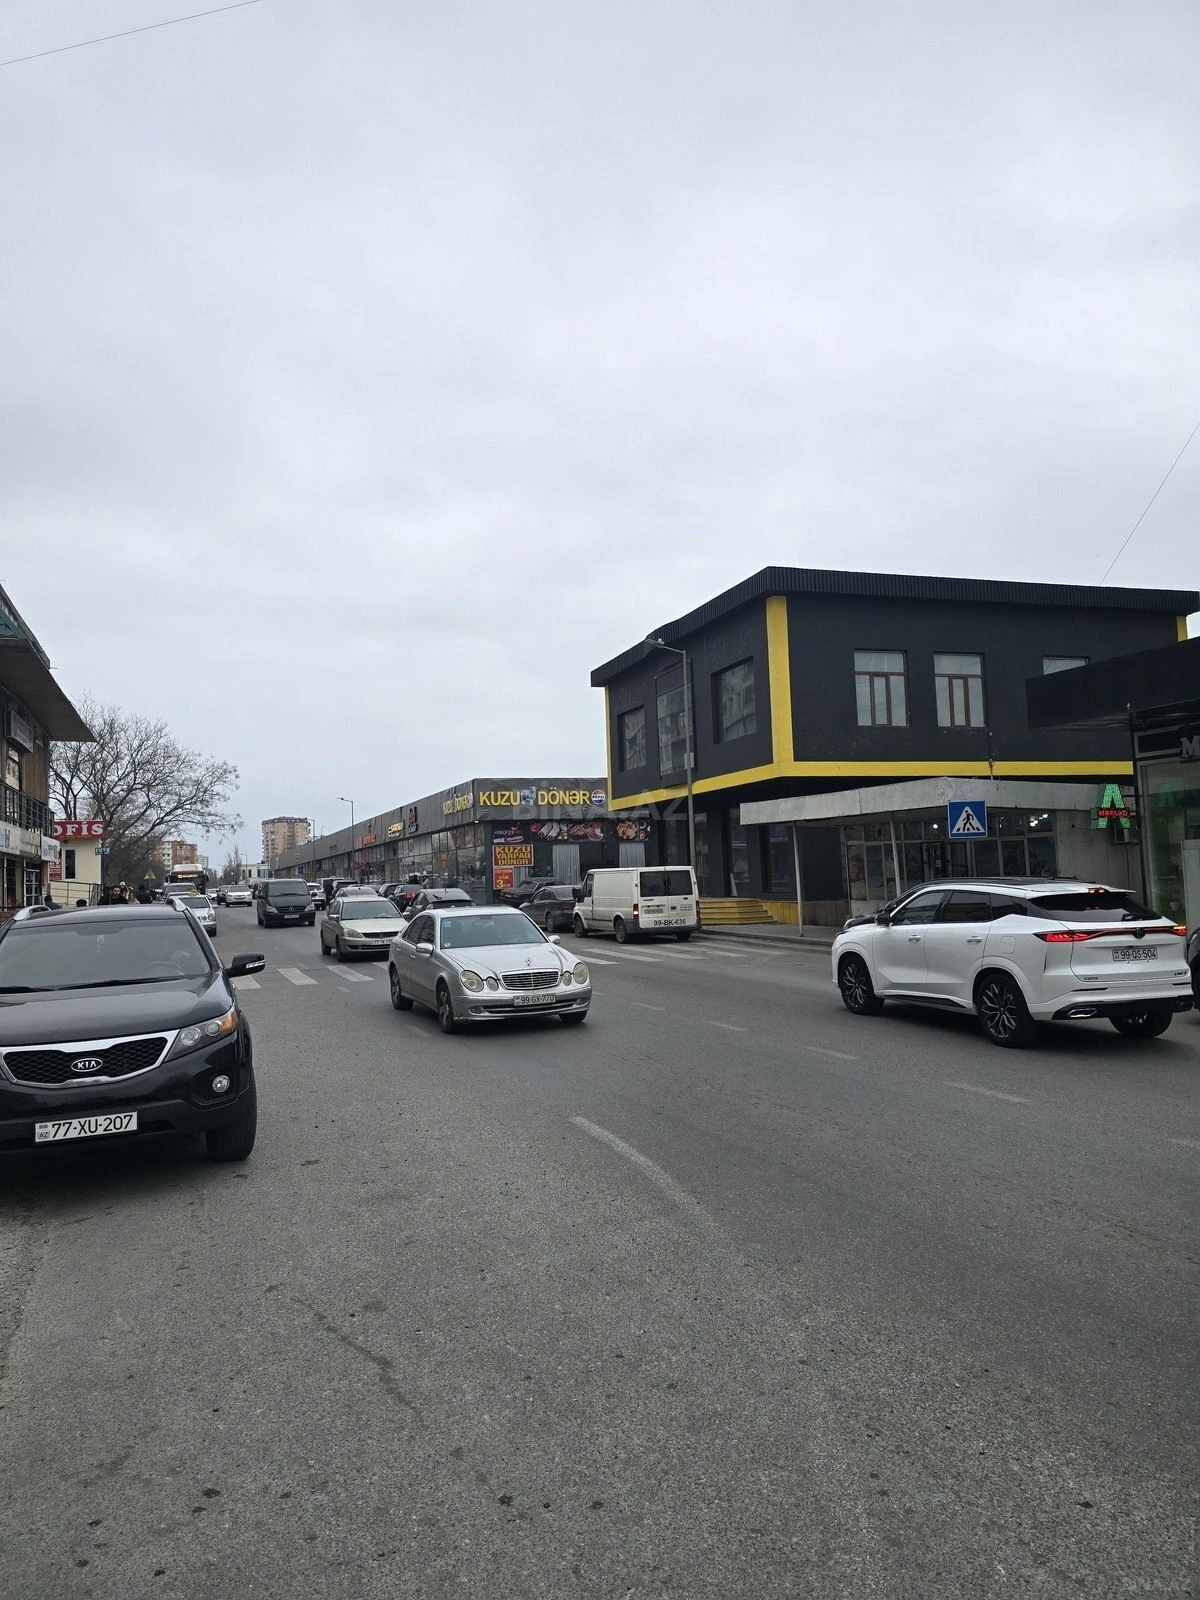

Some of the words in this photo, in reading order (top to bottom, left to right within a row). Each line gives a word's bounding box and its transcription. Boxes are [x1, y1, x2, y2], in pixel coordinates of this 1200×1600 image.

[479, 790, 521, 806] KUZU
[537, 786, 590, 806] DÖNƏR
[1120, 948, 1157, 960] 99-QS-504
[77, 1060, 97, 1070] KIA
[52, 1114, 133, 1139] 77-XU-207
